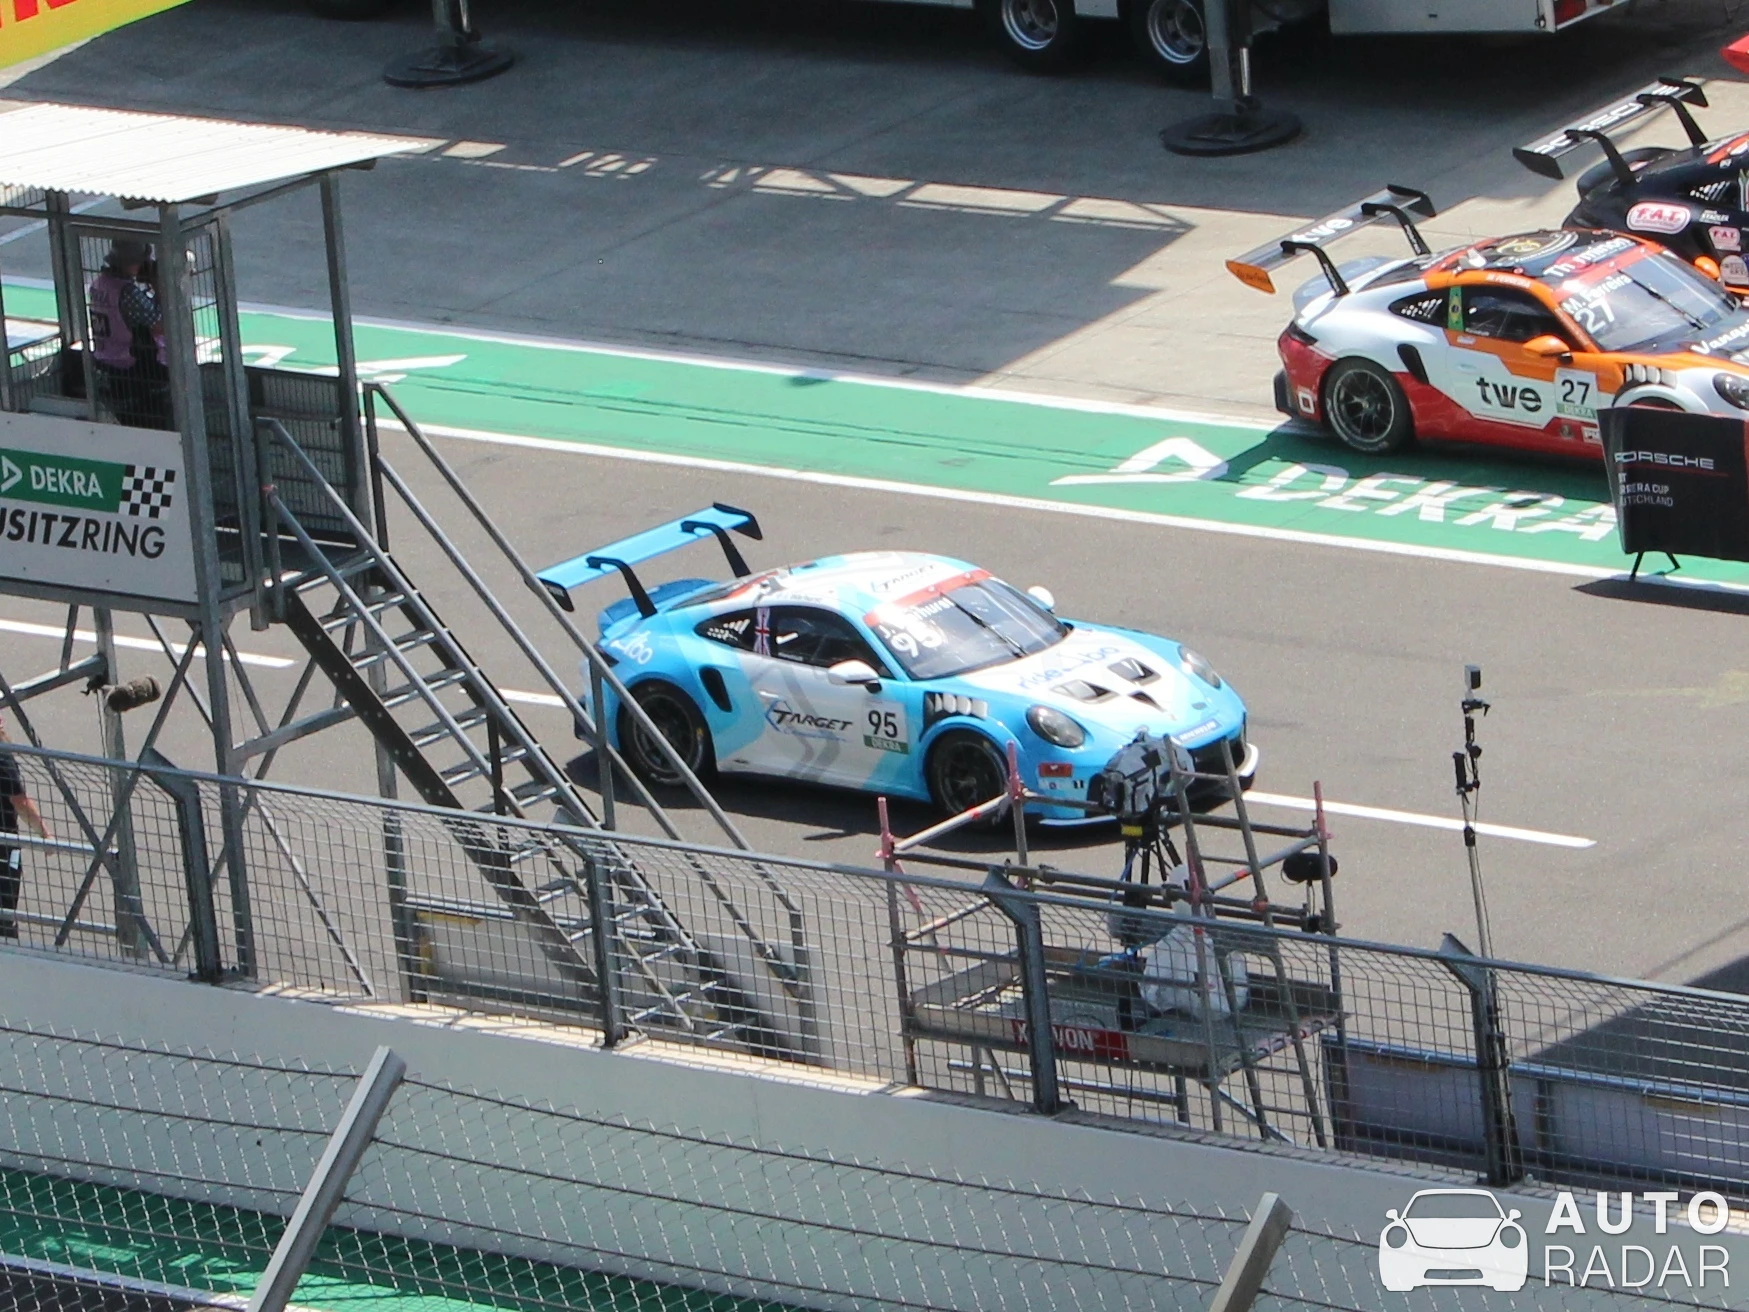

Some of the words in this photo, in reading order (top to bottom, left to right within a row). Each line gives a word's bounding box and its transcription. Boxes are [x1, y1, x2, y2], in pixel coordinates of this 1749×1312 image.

[1574, 299, 1616, 335] 27
[1476, 377, 1542, 413] twe
[1560, 379, 1590, 406] 27
[1614, 450, 1715, 470] PORSCHE
[29, 464, 104, 499] DEKRA
[1651, 484, 1670, 495] CUP
[1235, 461, 1616, 542] DEKRA
[774, 708, 853, 731] TARGET
[867, 710, 898, 738] 95
